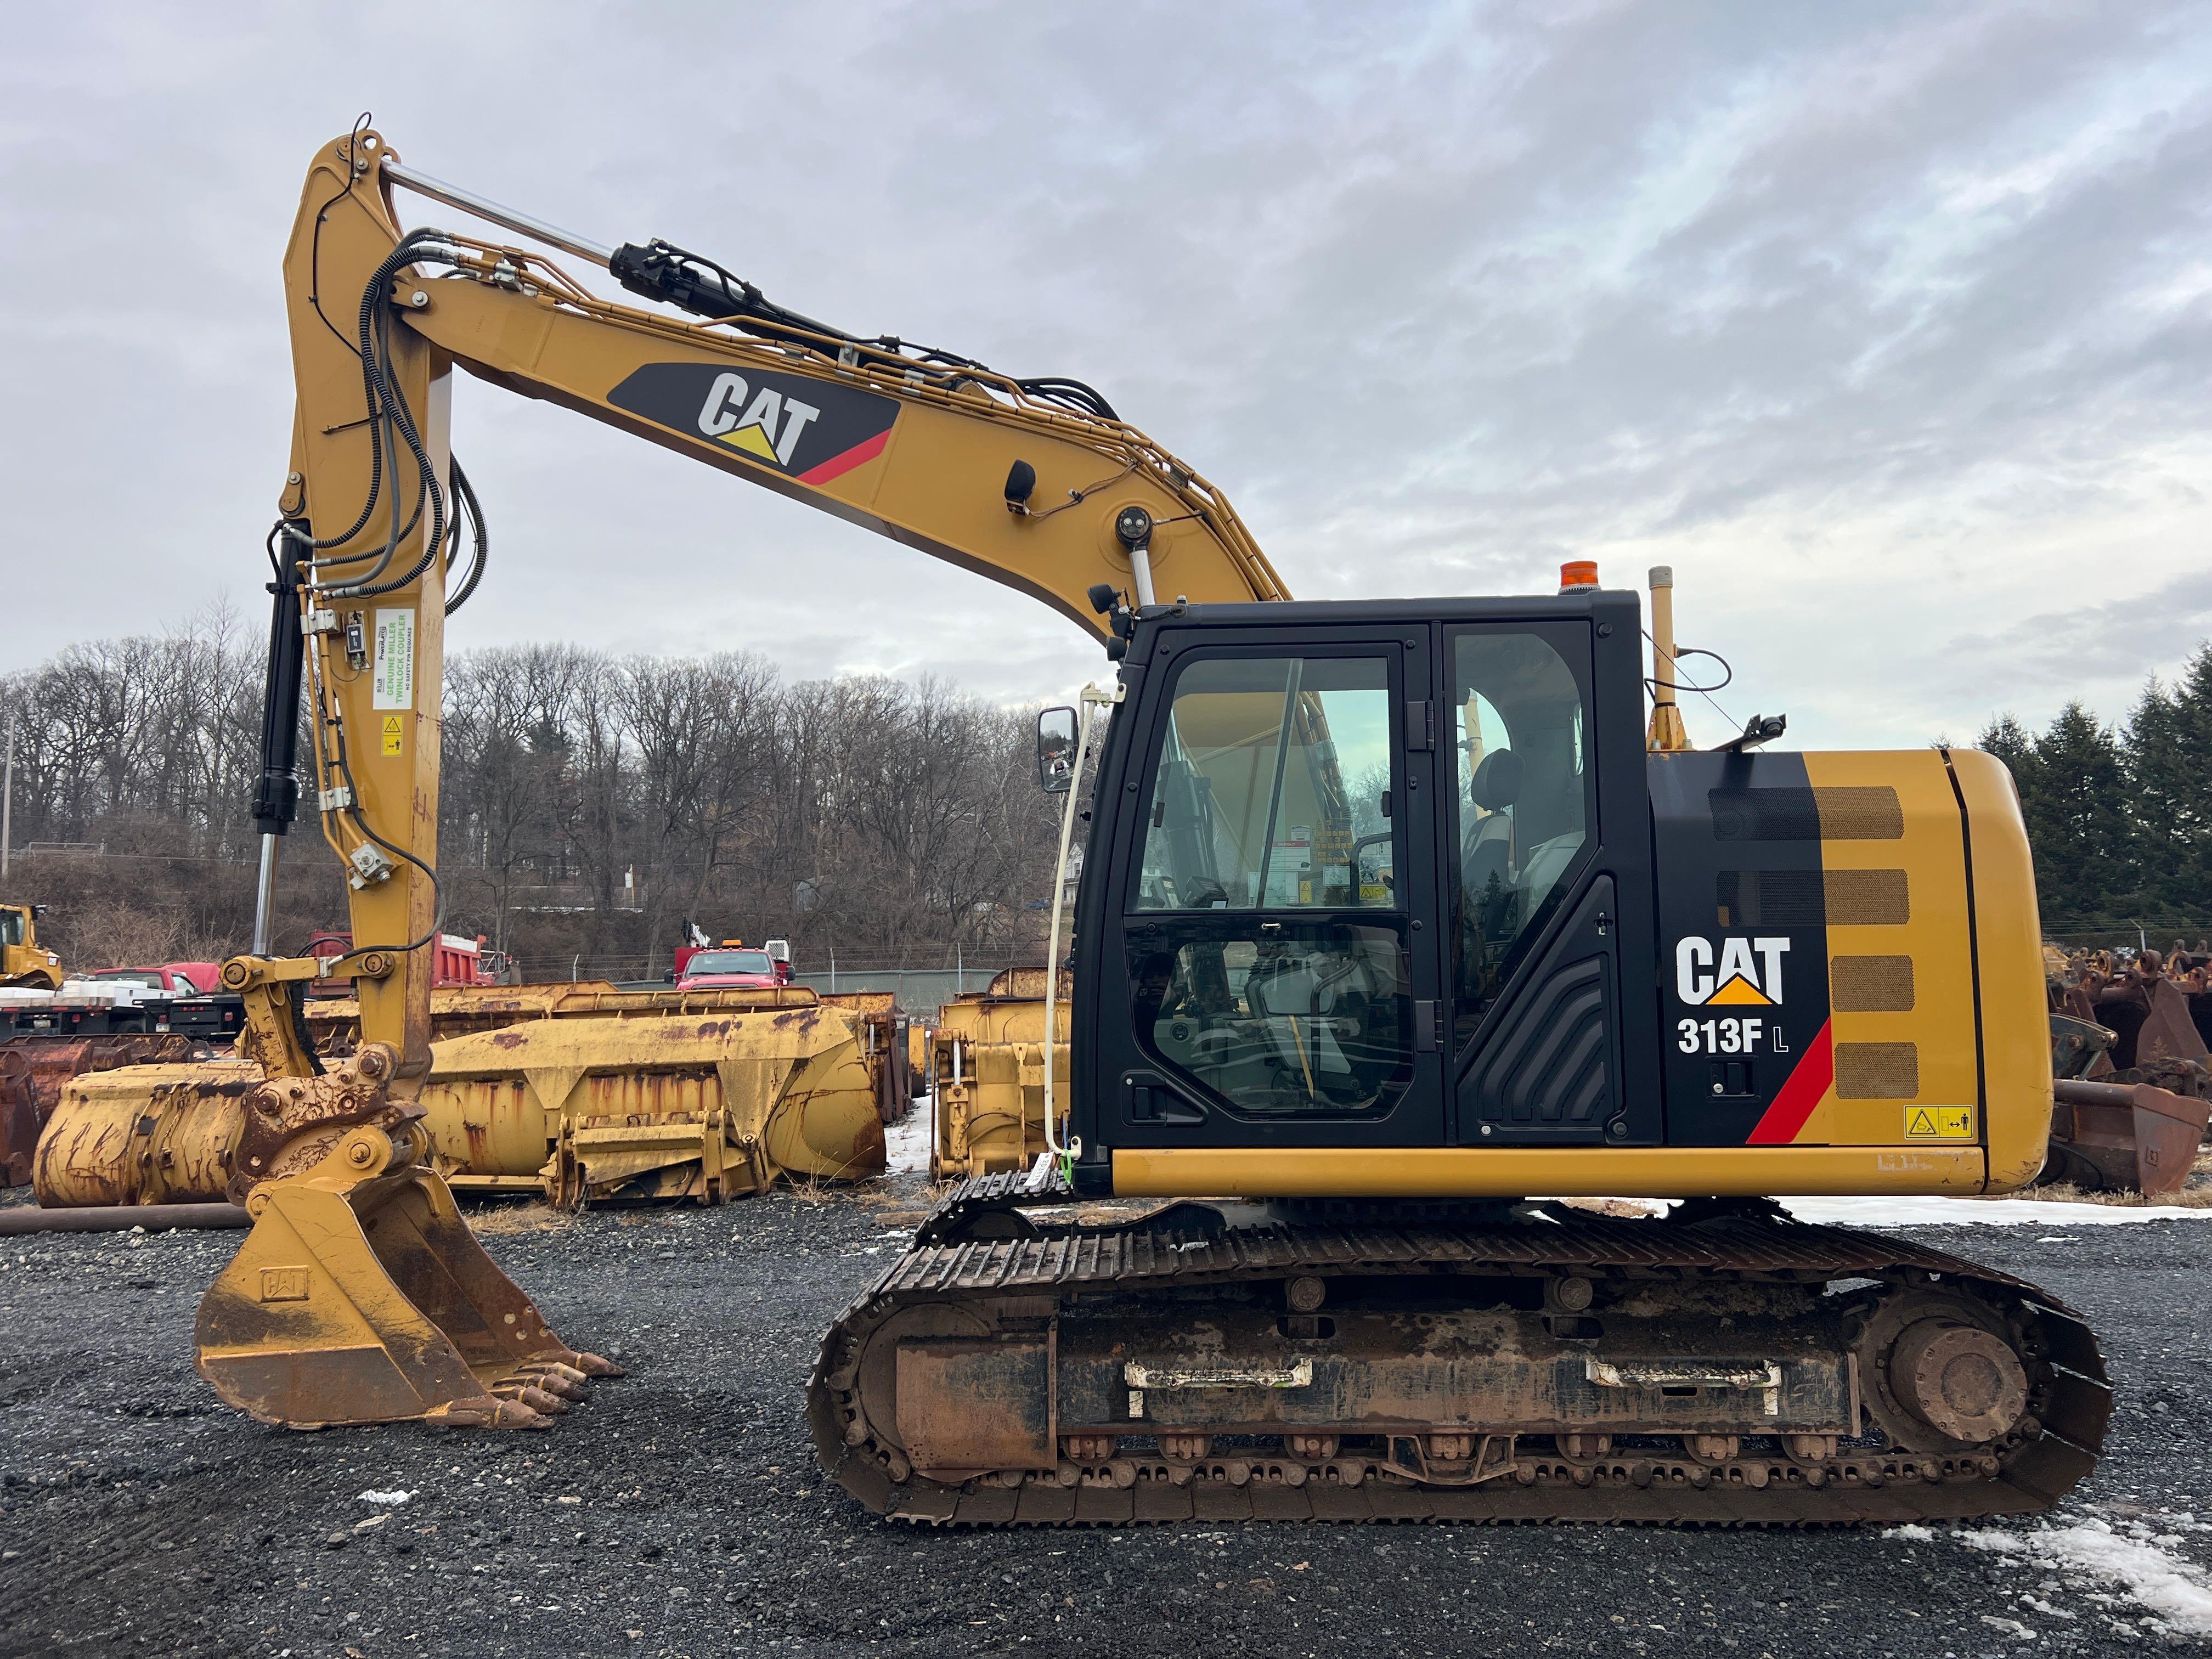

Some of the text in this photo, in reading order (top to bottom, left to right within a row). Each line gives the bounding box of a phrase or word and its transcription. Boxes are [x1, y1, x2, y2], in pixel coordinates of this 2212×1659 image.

[698, 372, 821, 466] CAT
[1676, 936, 1790, 1005] CAT
[1678, 1018, 1788, 1053] 313F L
